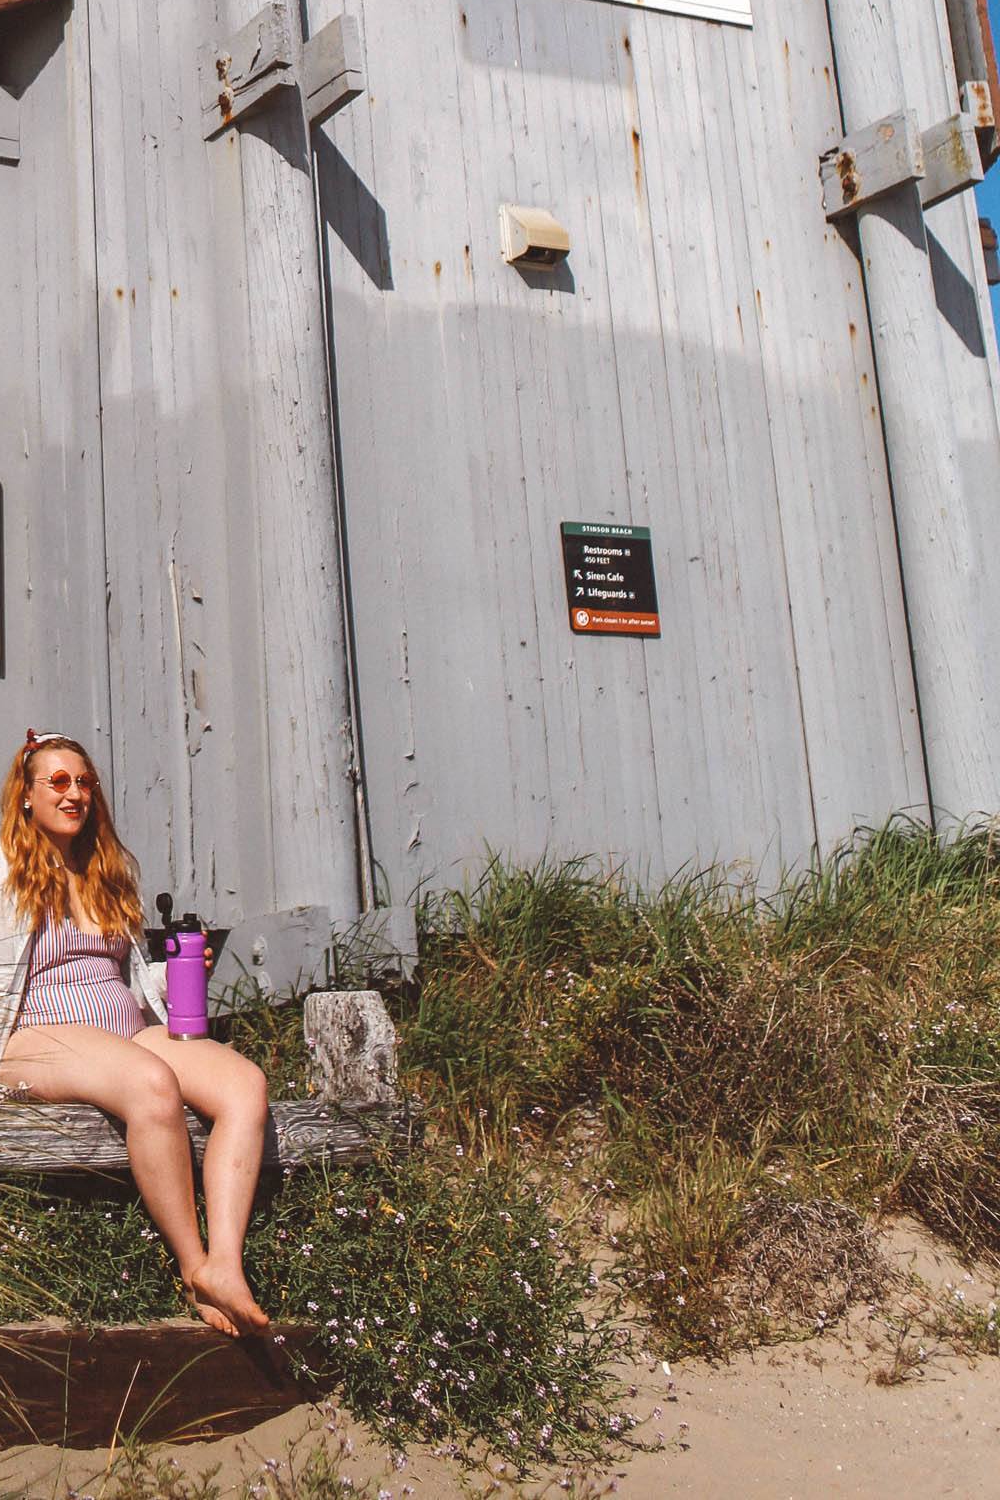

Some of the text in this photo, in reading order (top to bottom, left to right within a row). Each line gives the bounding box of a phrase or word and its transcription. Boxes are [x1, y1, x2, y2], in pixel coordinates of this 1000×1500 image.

[583, 525, 609, 533] STINSON
[584, 545, 622, 556] Restrooms
[586, 571, 624, 582] Siren Cafe
[588, 588, 627, 599] Lifeguards
